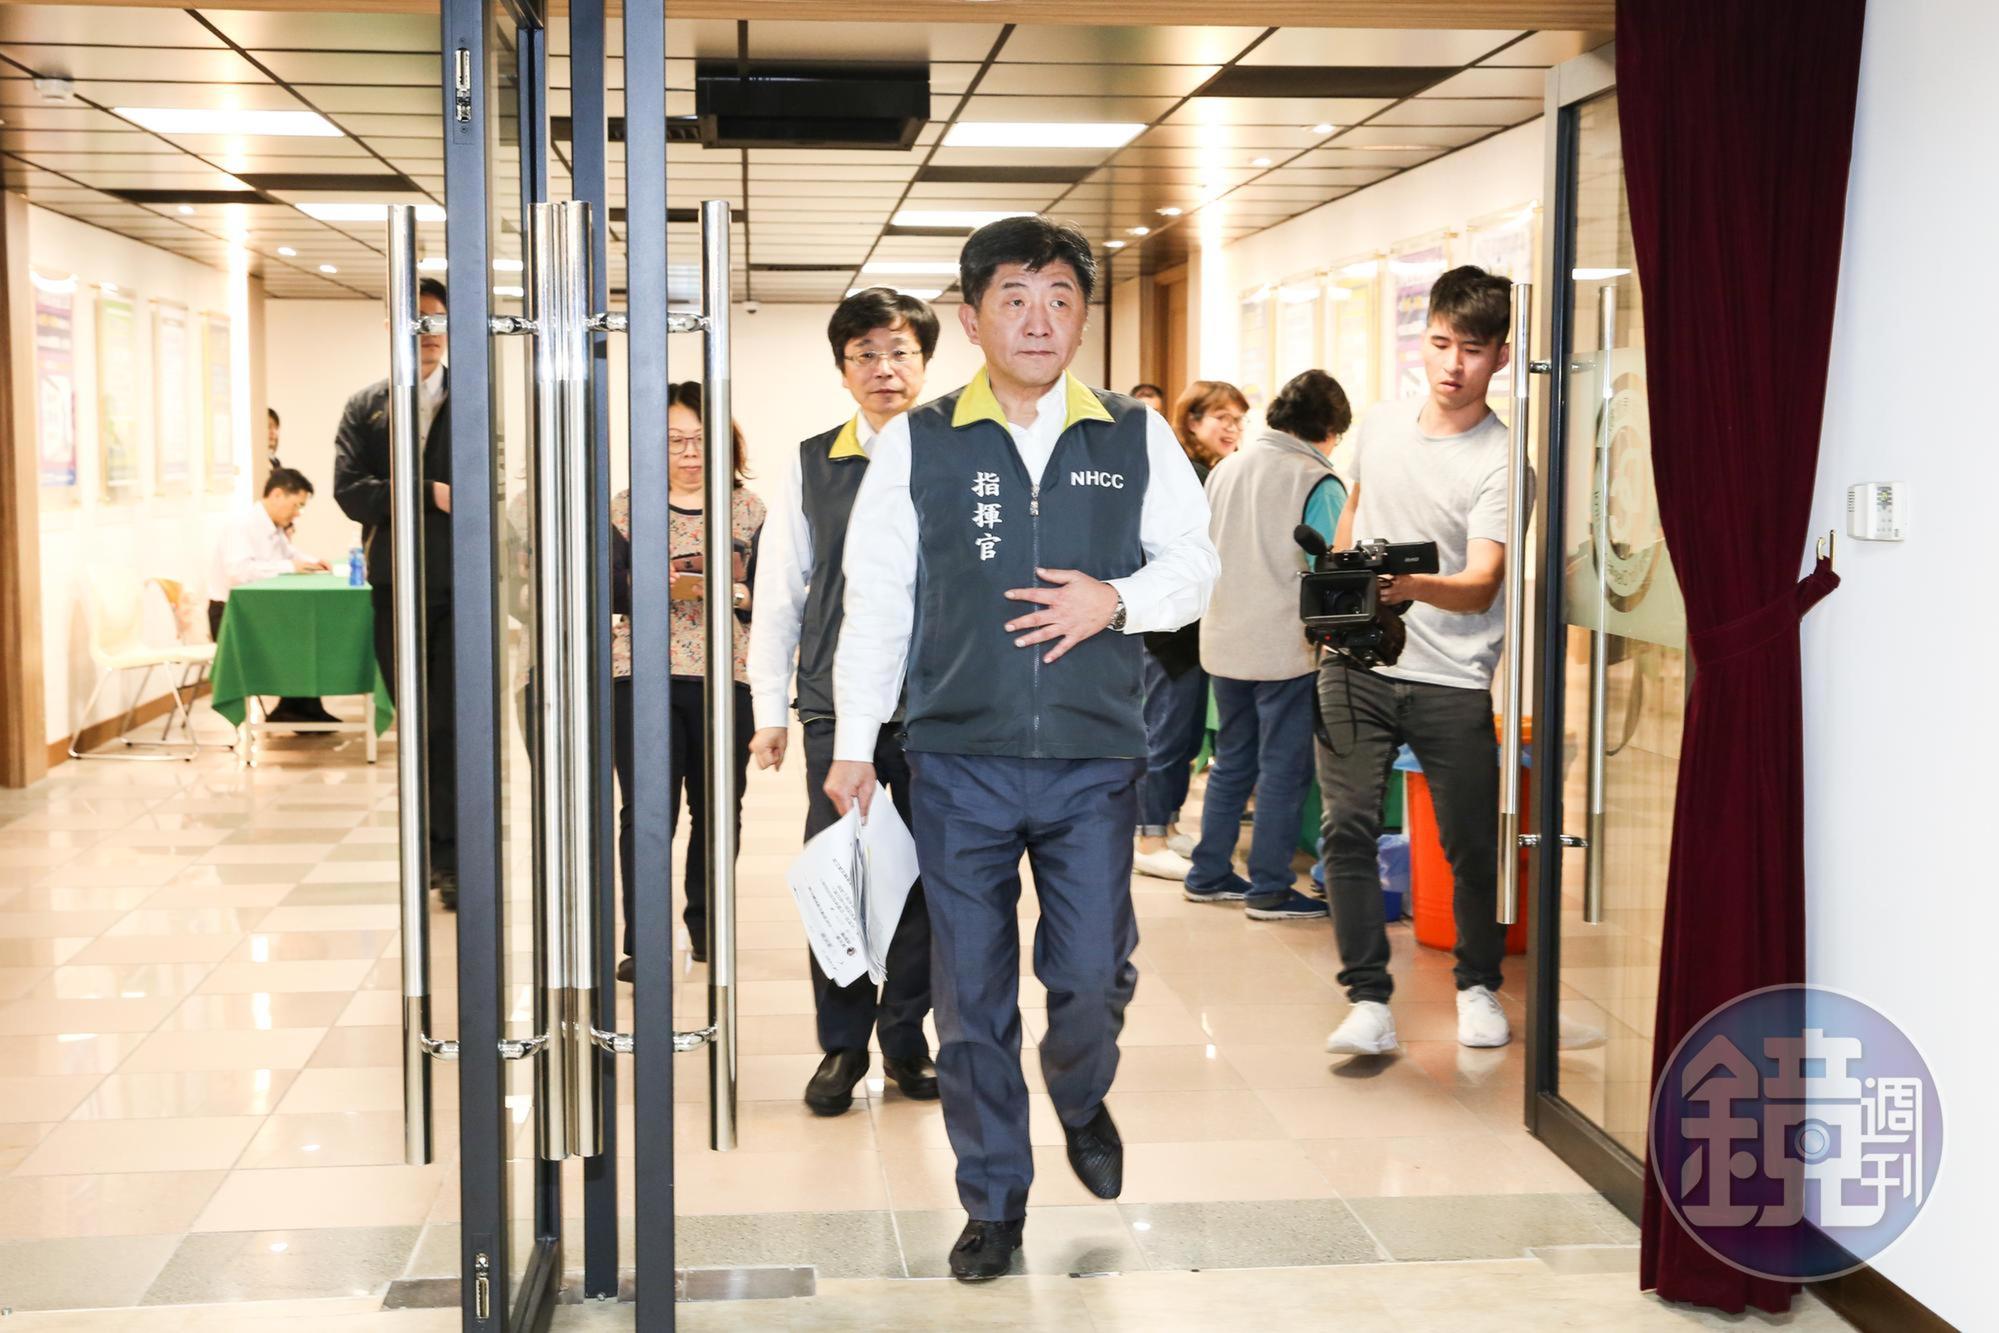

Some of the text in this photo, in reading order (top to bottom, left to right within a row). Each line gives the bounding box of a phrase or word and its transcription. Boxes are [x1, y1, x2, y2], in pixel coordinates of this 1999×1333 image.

[1070, 471, 1124, 489] NHCC
[971, 471, 1002, 561] 指揮官
